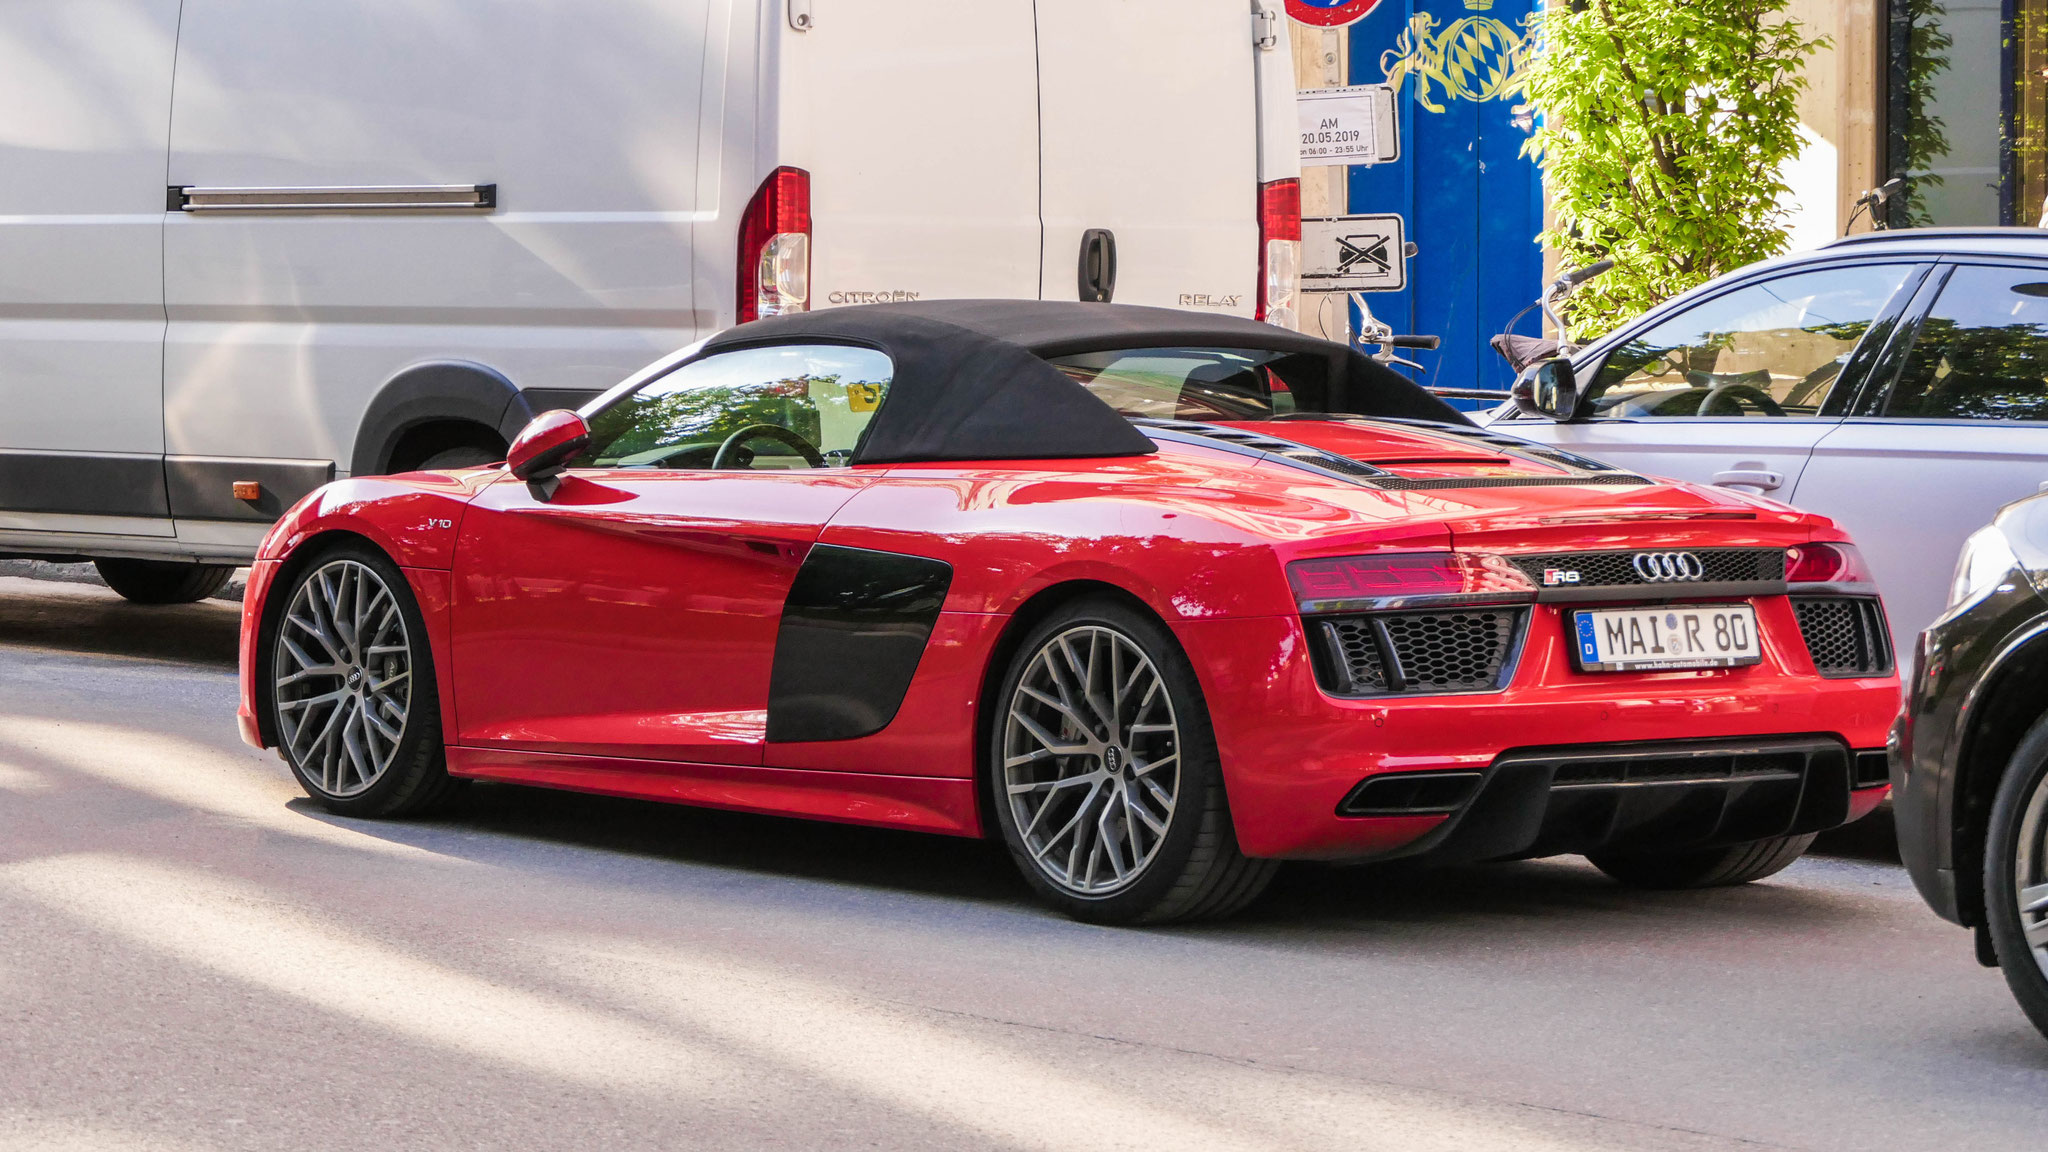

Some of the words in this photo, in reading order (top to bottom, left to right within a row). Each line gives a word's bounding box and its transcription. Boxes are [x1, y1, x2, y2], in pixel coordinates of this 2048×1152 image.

[1320, 118, 1338, 129] AM
[1301, 130, 1360, 144] 20.05.2019
[1308, 147, 1327, 155] 06:00
[1356, 144, 1369, 152] Uhr
[828, 290, 919, 303] CITROËN
[1179, 293, 1242, 306] RELAY
[428, 518, 452, 528] V10
[1551, 570, 1581, 583] R8
[1605, 616, 1665, 655] MAI
[1683, 614, 1704, 652] R
[1713, 613, 1748, 652] 80
[1585, 643, 1593, 655] D
[1634, 659, 1719, 669] www.hahn-automobile.de
